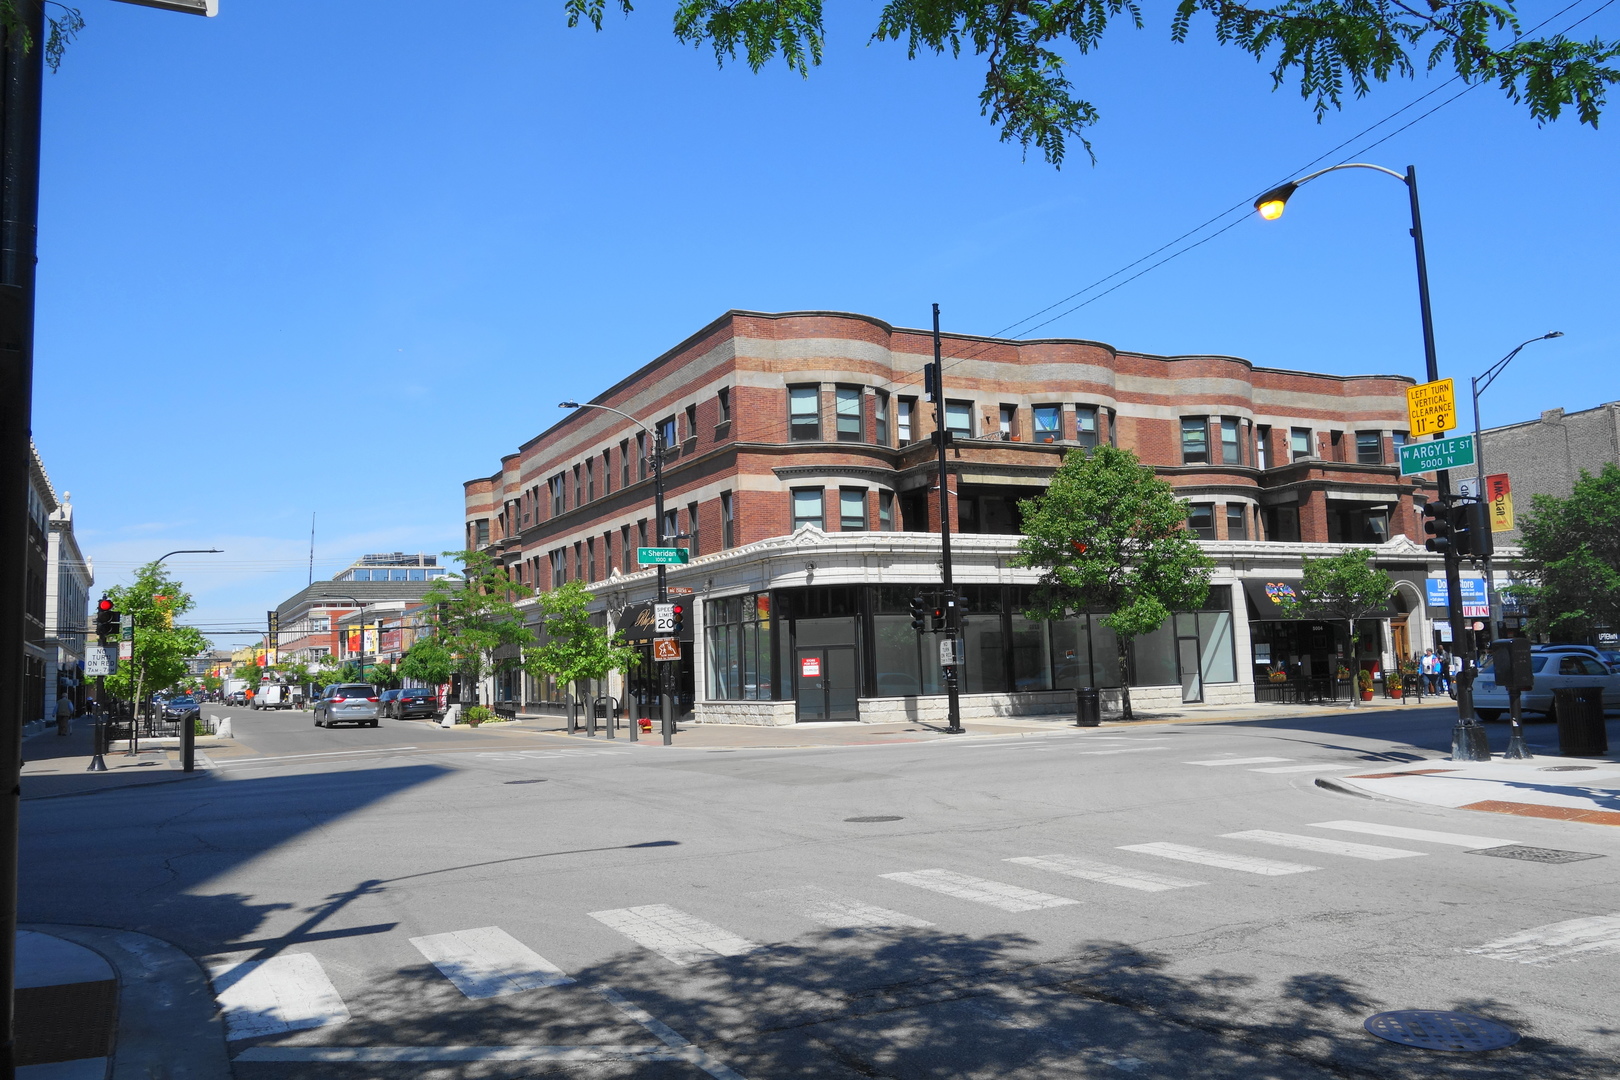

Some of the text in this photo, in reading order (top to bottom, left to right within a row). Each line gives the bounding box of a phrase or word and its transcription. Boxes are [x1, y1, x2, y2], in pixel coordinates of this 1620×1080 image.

[1411, 384, 1449, 399] LEFT TURN
[1414, 394, 1447, 408] VERTICAL
[1411, 402, 1452, 418] CLEARANCE
[1403, 440, 1470, 459] W ARGYLE ST
[1420, 456, 1453, 468] 5000 N
[657, 618, 674, 629] 20
